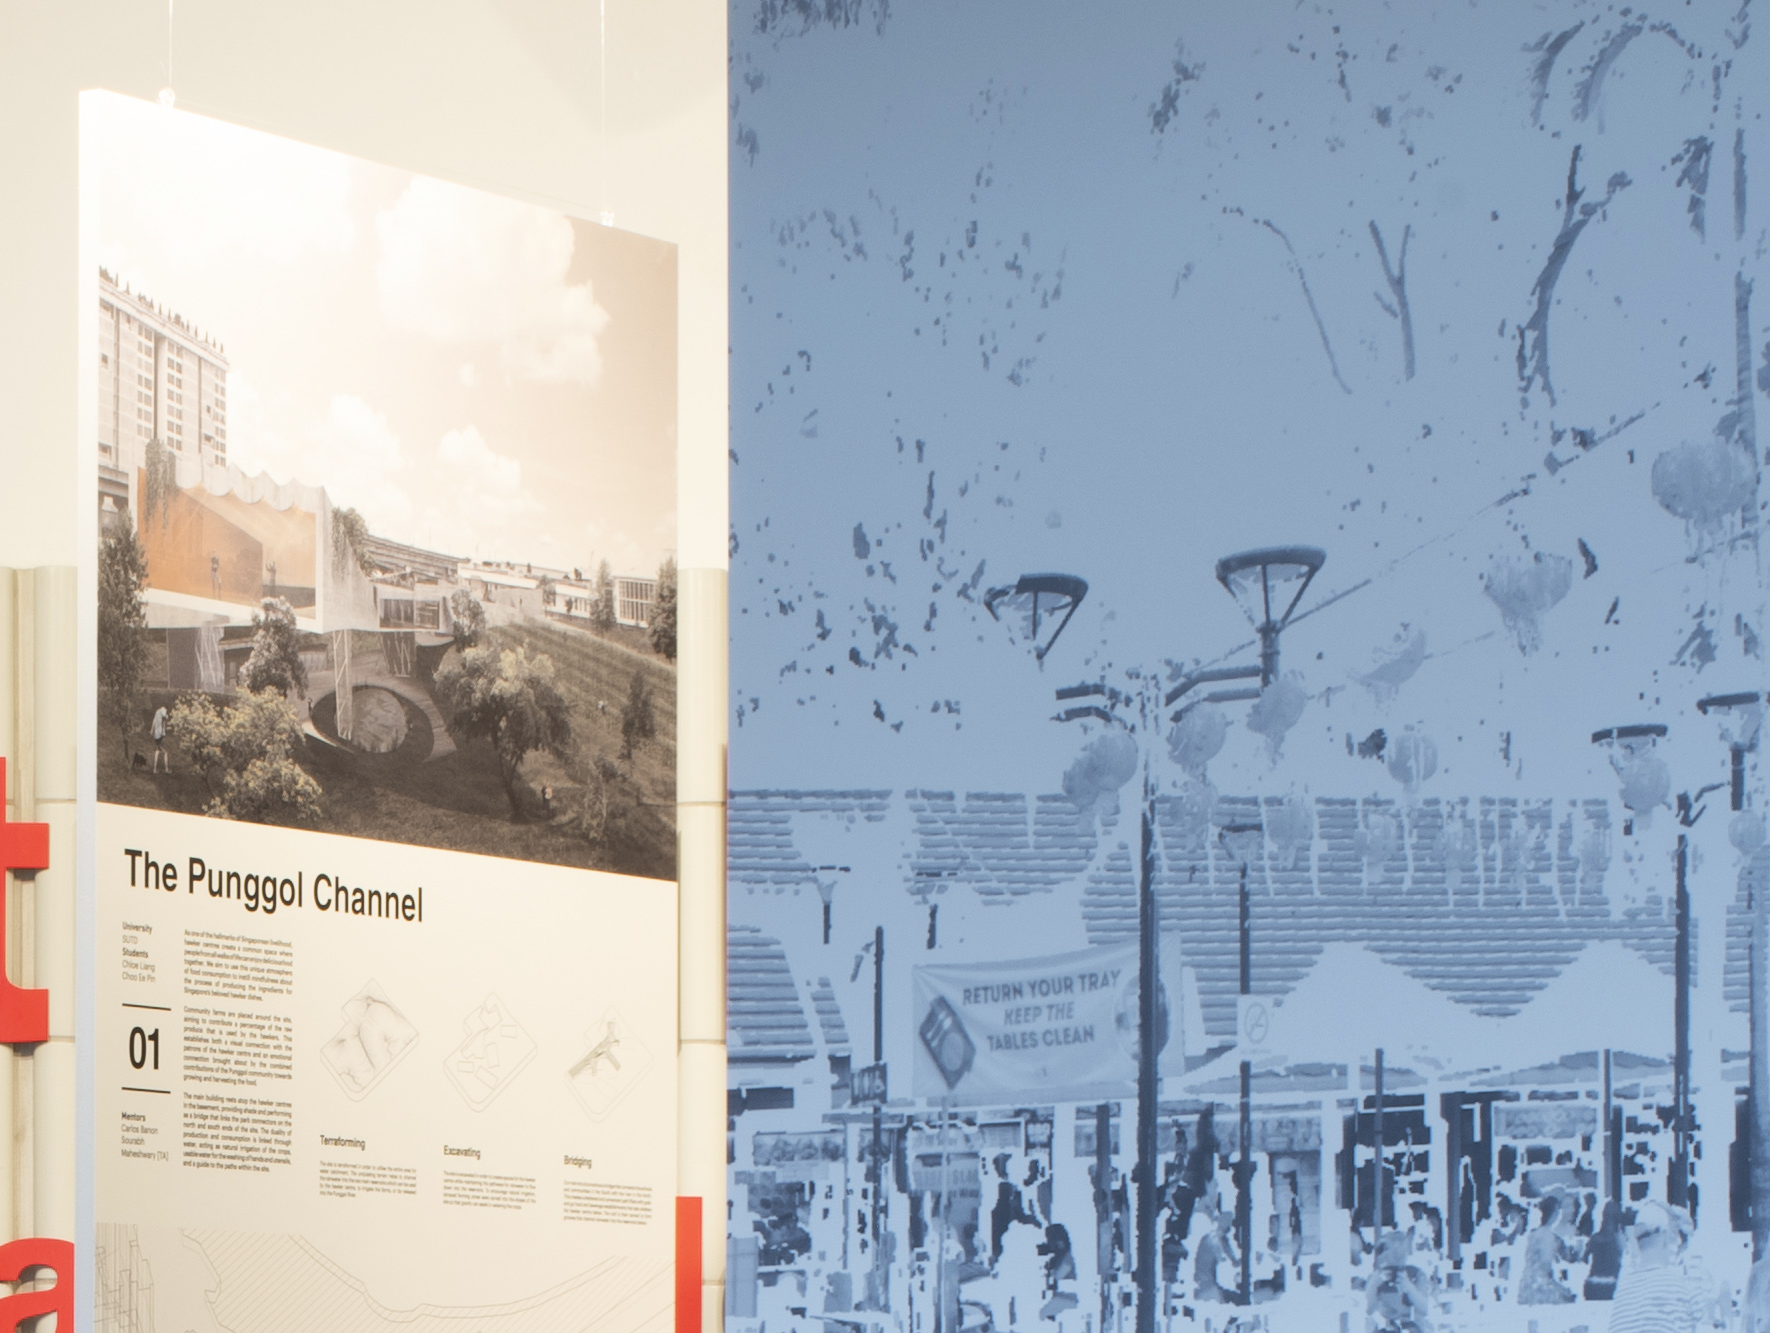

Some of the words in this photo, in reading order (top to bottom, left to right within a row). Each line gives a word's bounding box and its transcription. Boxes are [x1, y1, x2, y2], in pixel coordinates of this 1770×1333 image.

[124, 849, 177, 892] The
[189, 858, 303, 914] Punggol
[314, 872, 423, 922] Channel
[122, 922, 152, 934] University
[122, 947, 148, 958] Students
[963, 982, 1023, 1005] RETURN
[1029, 976, 1074, 998] YOUR
[1077, 969, 1122, 992] TRAY
[1003, 1005, 1043, 1026] KEEP
[1046, 1001, 1074, 1021] THE
[987, 1031, 1039, 1052] TABLES
[1043, 1025, 1095, 1047] CLEAN
[128, 1026, 161, 1070] 01
[121, 1111, 146, 1122] Mentors
[320, 1135, 366, 1151] Terraforming
[443, 1145, 481, 1160] Excavating
[564, 1155, 592, 1169] Bridging
